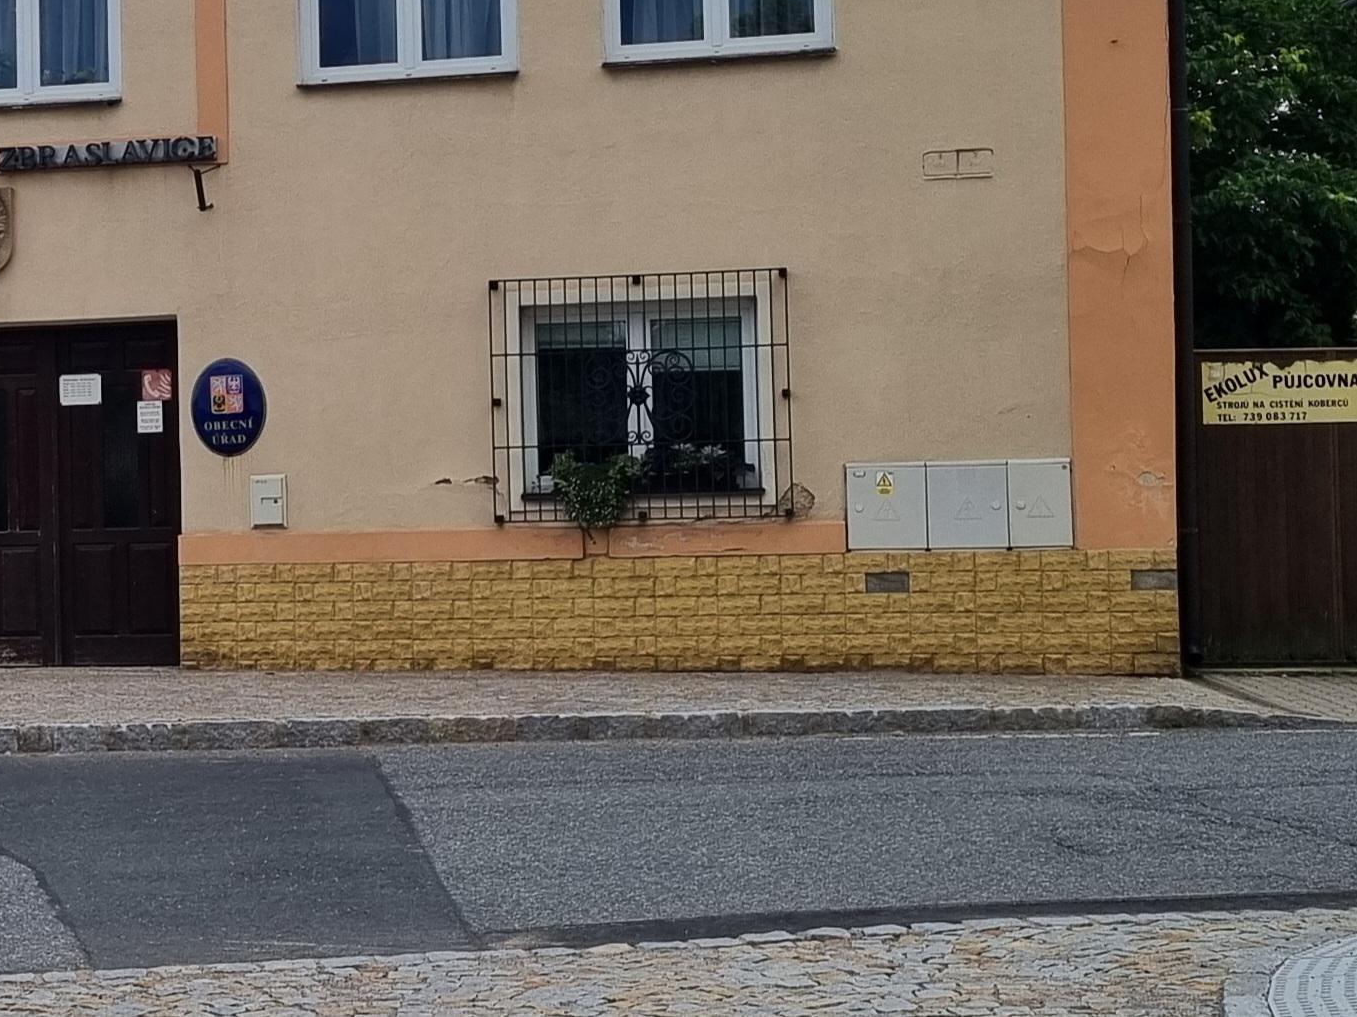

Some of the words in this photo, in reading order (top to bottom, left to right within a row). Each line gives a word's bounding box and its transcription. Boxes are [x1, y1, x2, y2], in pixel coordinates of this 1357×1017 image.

[1204, 364, 1269, 403] EKOLUX
[1272, 371, 1357, 389] PŮJCOVNA
[1252, 401, 1265, 409] NA
[1218, 413, 1236, 422] TEL:
[1244, 412, 1263, 421] 739
[1266, 412, 1286, 421] 083
[1290, 411, 1307, 420] 717
[204, 416, 253, 431] OBECNÍ
[212, 433, 246, 445] ÚŘAD
